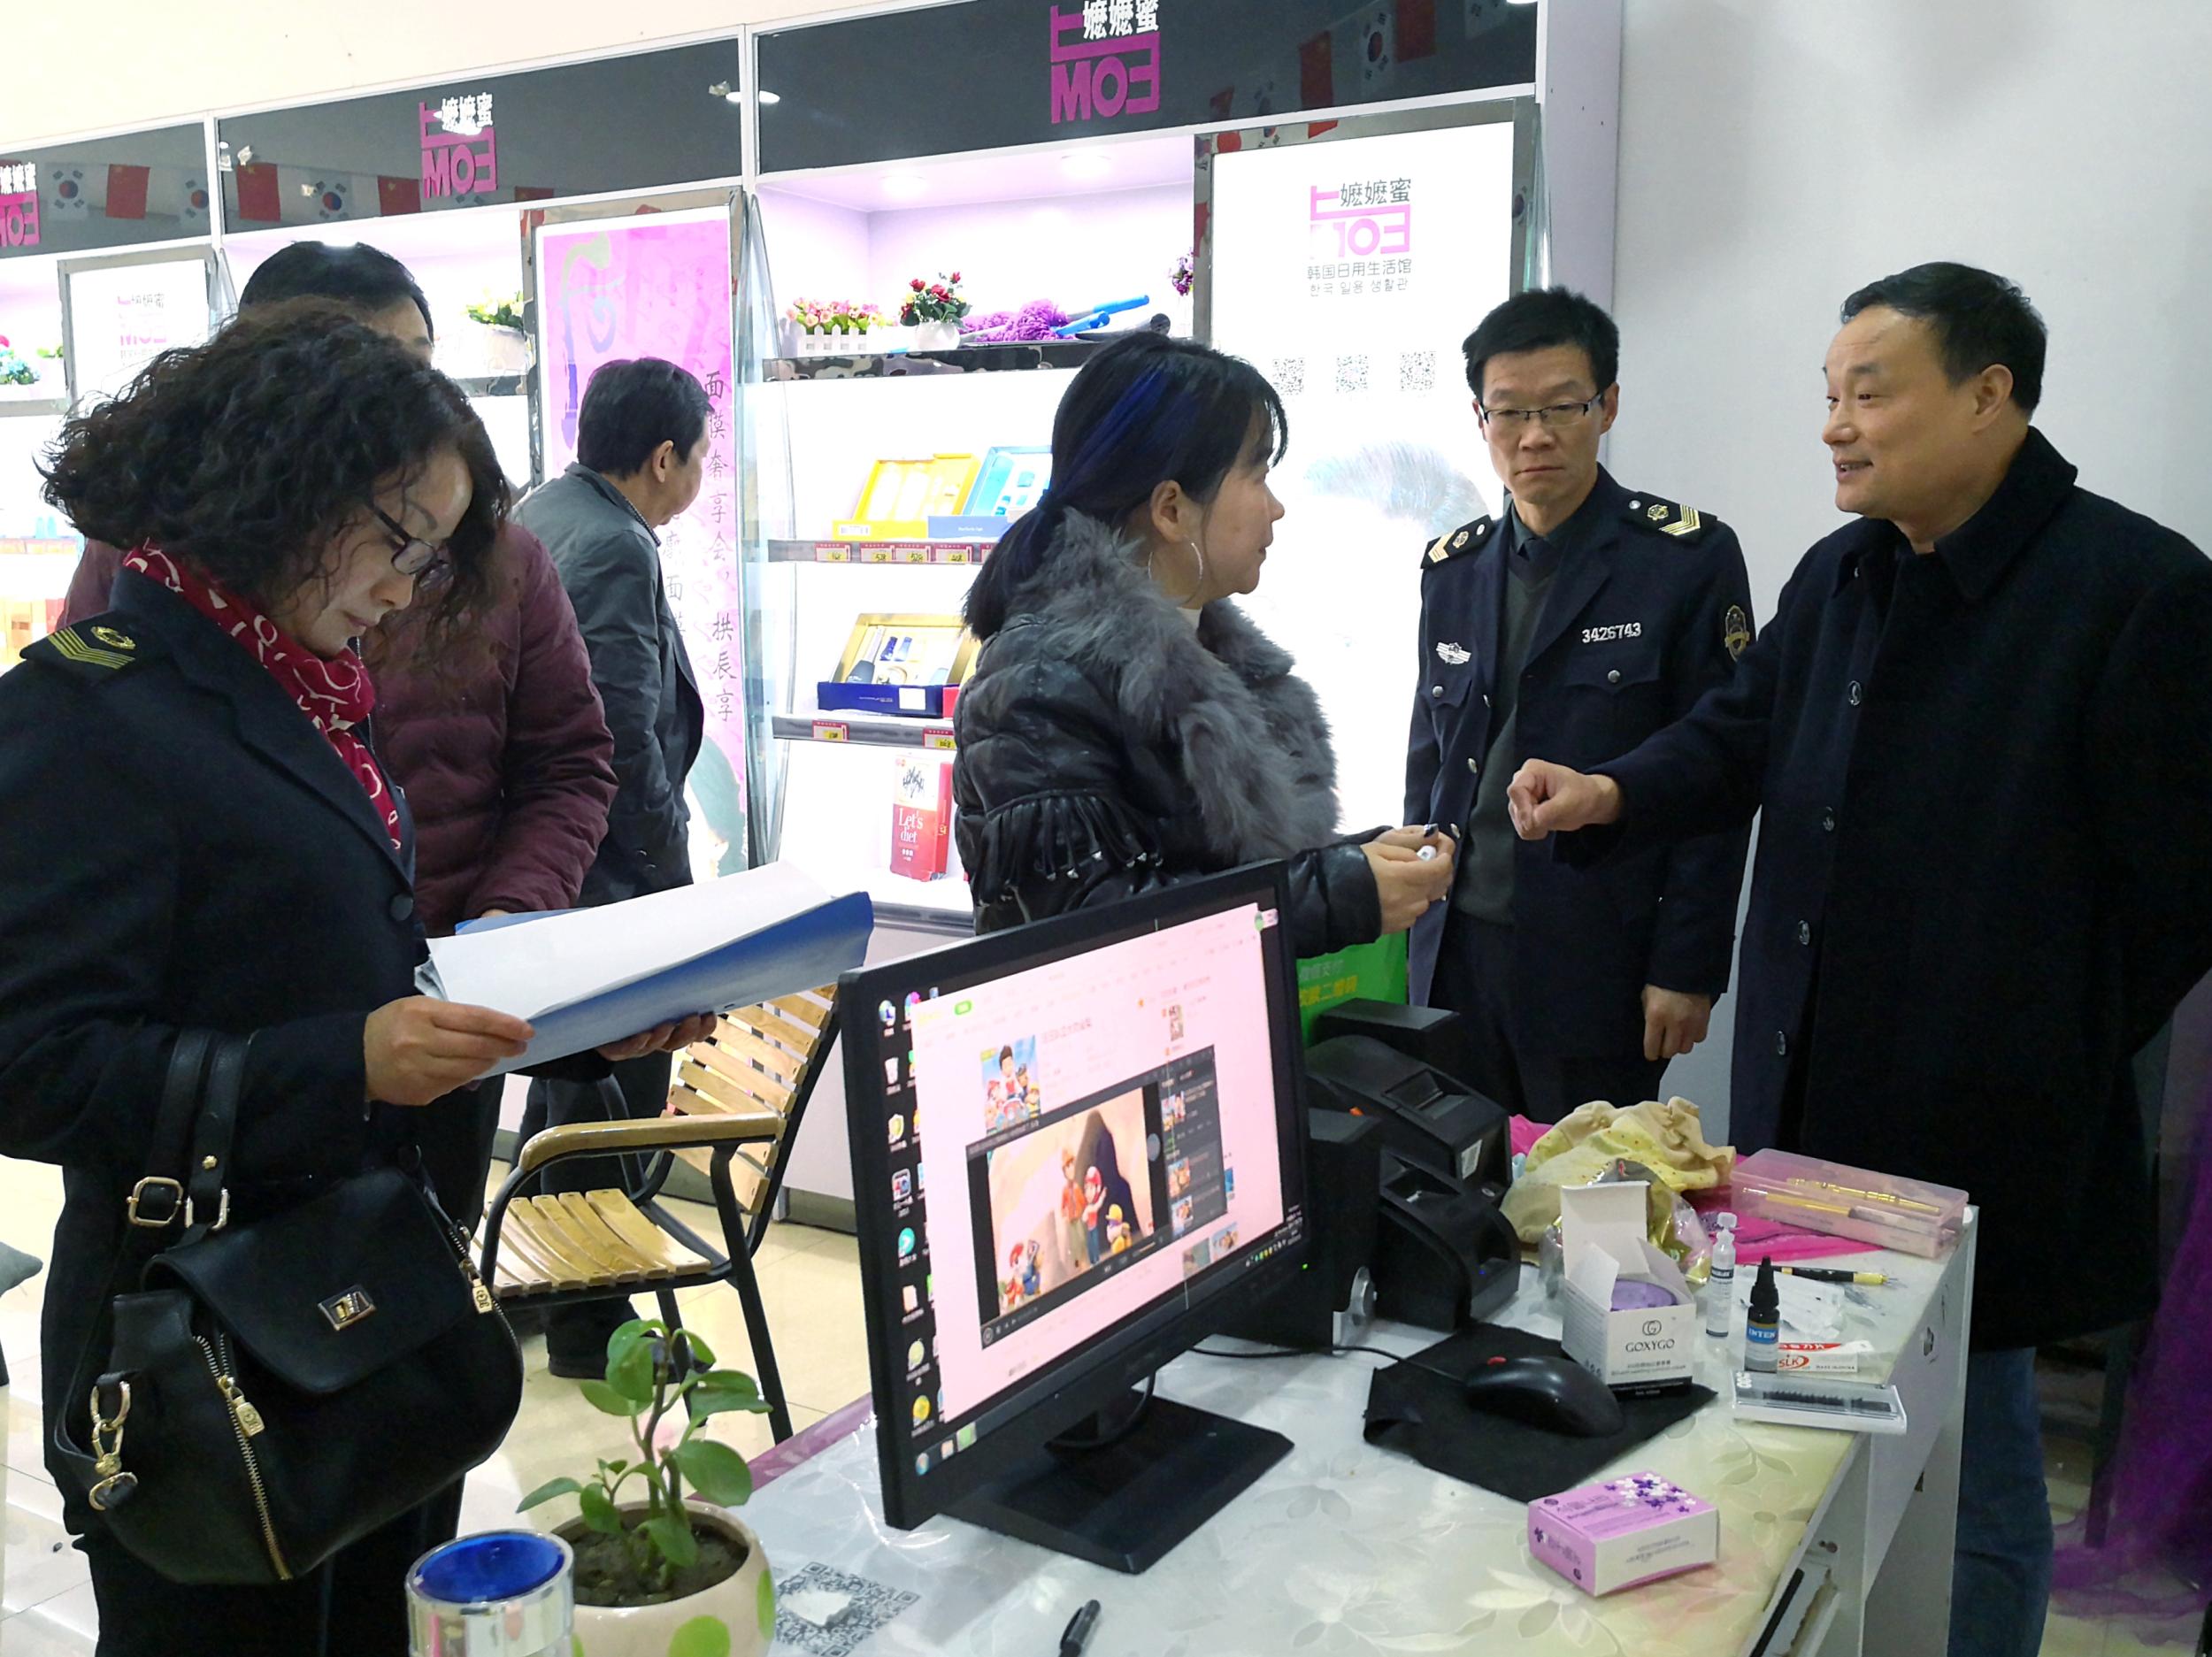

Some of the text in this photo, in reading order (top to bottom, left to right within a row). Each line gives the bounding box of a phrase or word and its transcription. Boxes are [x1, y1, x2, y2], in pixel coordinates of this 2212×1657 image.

[1340, 177, 1411, 208] 嬷嬷蜜
[1307, 258, 1412, 280] 韩国日用生活馆
[1581, 622, 1642, 643] 3426743
[898, 807, 924, 830] Let's
[900, 827, 918, 843] diet
[1625, 1339, 1675, 1353] GOXYGO
